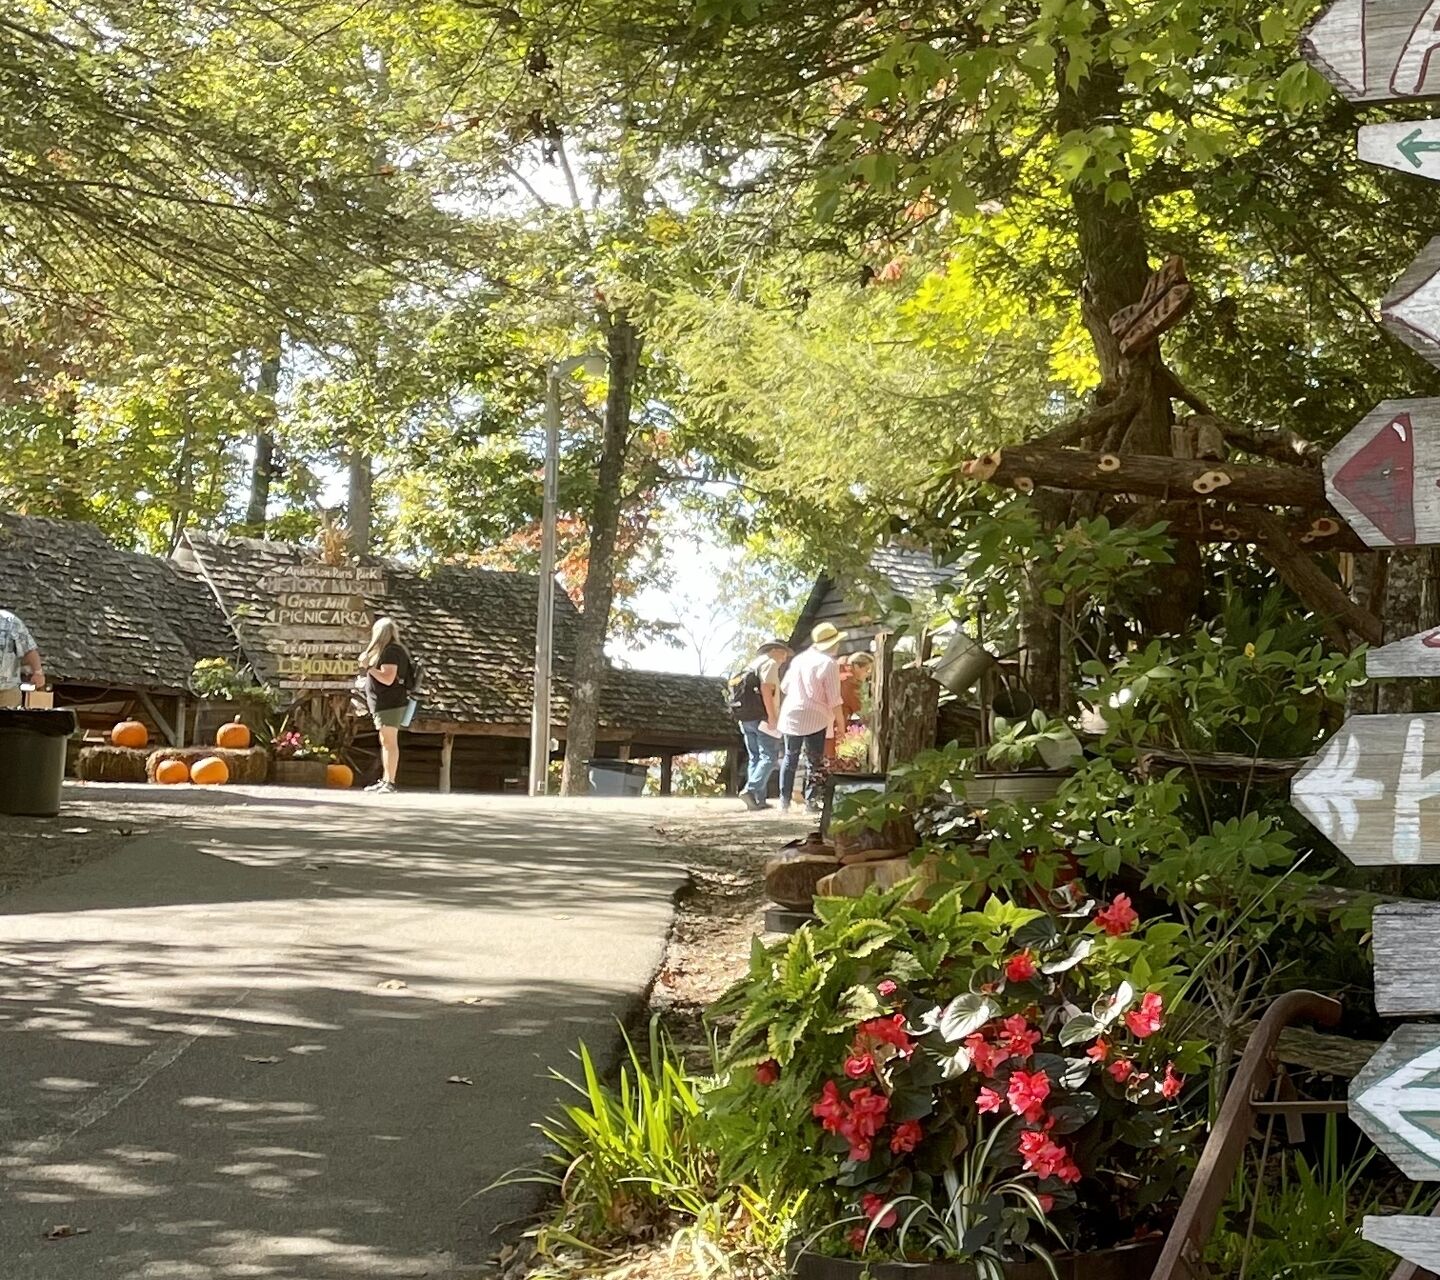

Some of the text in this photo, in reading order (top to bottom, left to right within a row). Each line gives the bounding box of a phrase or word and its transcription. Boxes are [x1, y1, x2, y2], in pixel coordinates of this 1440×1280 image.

[279, 610, 370, 627] PICNIC AREA
[277, 658, 360, 675] LEMONADE
